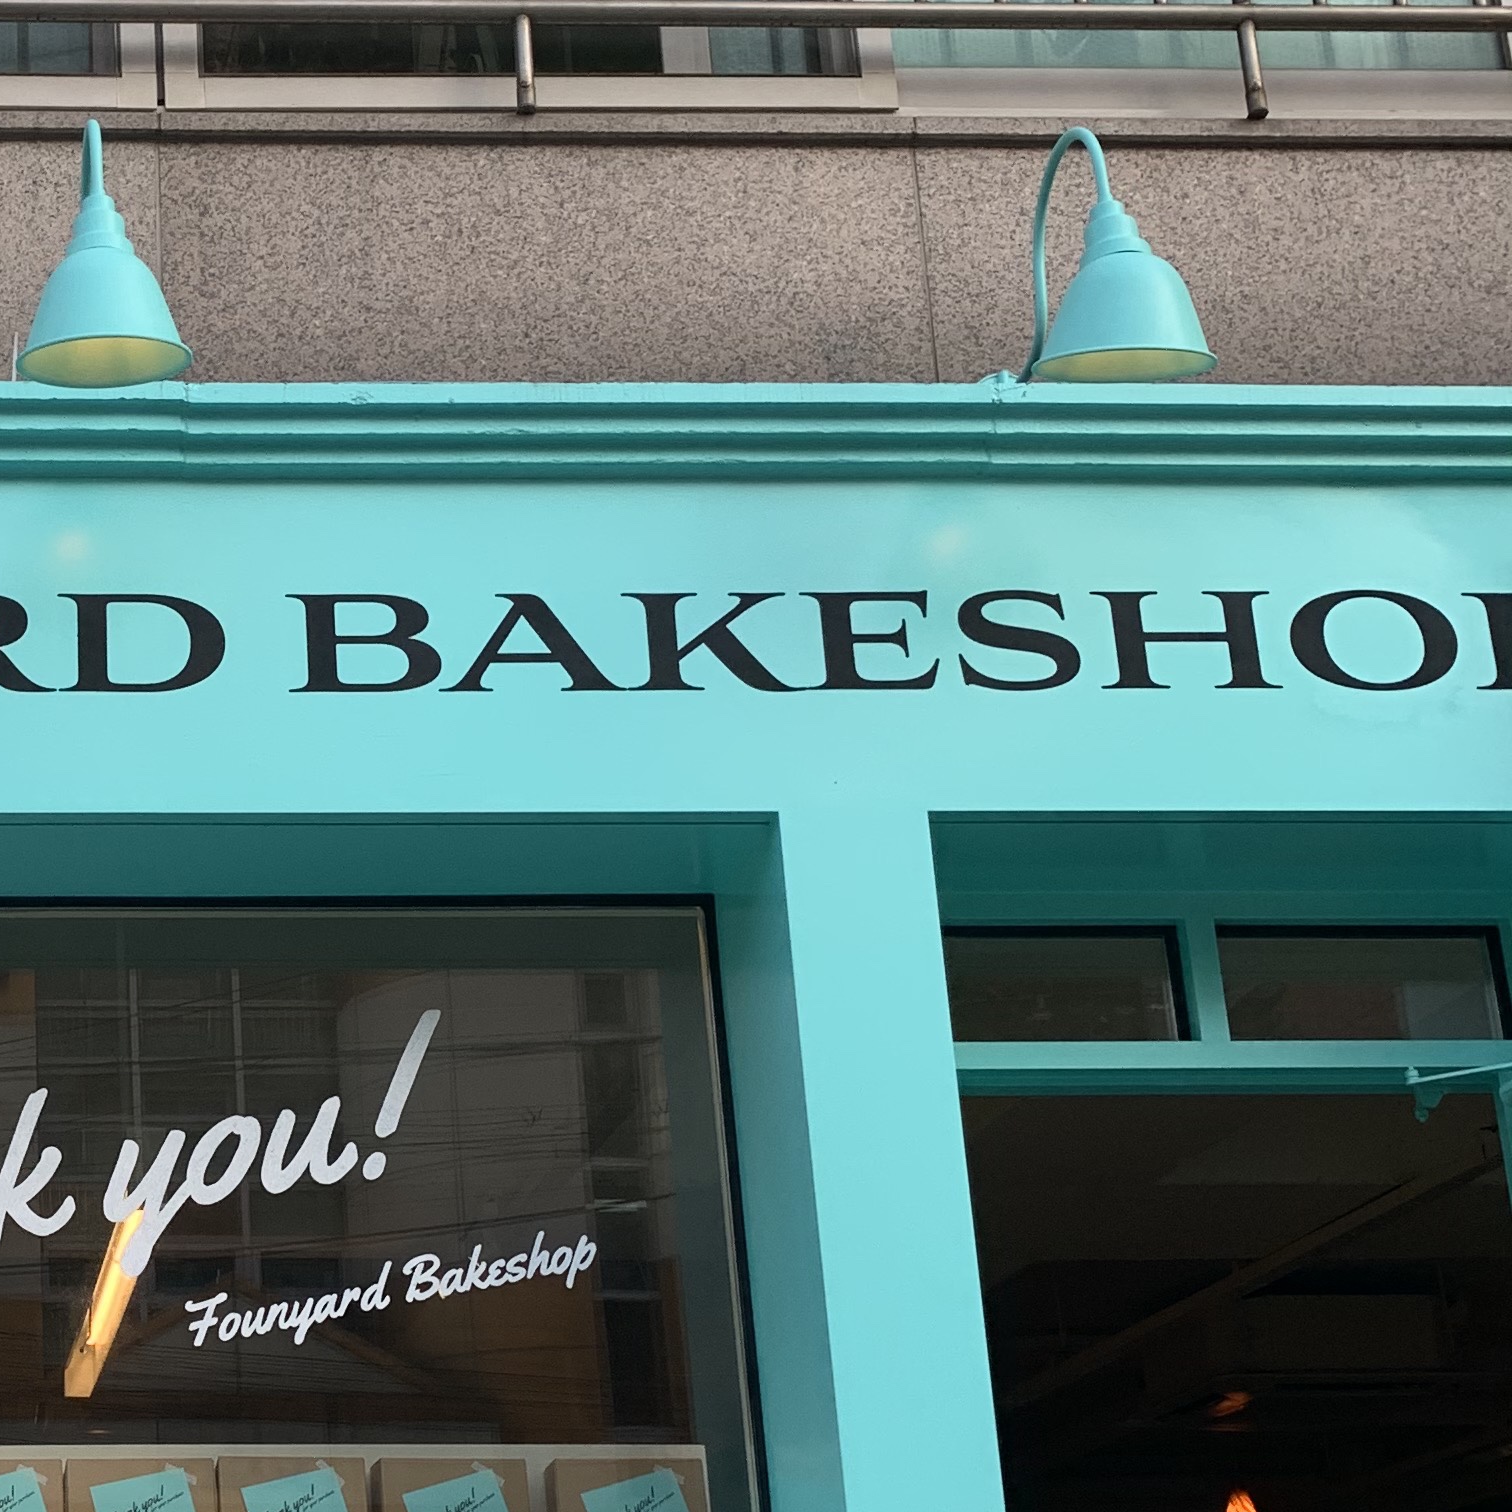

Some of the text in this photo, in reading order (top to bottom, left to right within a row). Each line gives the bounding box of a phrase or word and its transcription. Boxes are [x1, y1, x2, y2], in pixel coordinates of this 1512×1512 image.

[103, 1008, 442, 1278] you!
[183, 1231, 597, 1347] Founyard Bakeshop
